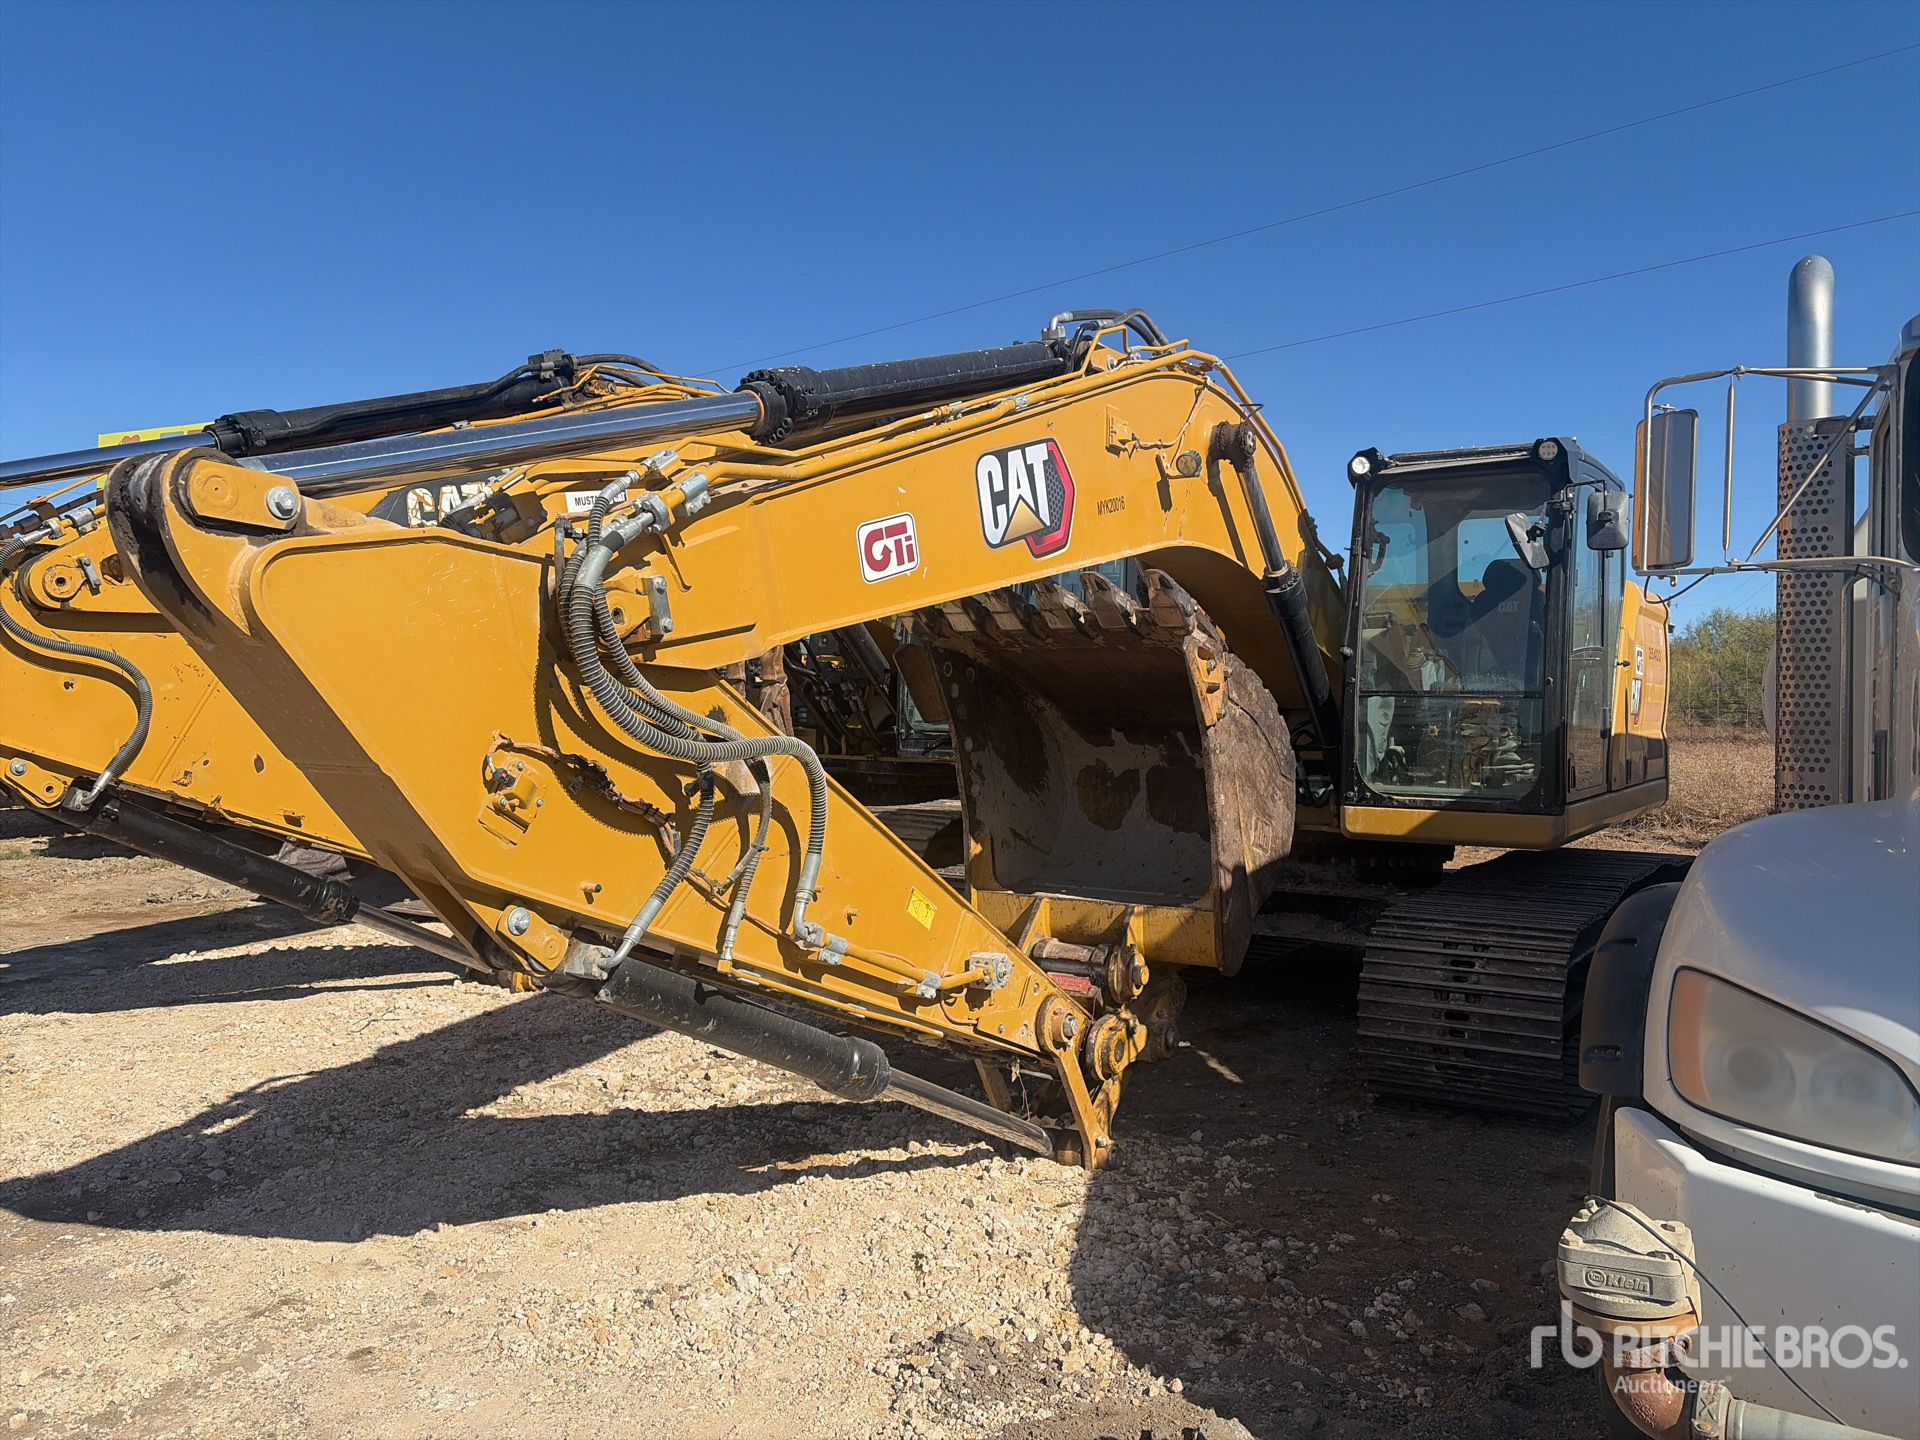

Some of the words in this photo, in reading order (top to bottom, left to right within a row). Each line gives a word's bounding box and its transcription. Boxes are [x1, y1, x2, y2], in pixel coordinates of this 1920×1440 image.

[977, 443, 1051, 544] CAT
[1096, 495, 1126, 516] MYK20016
[1605, 1273, 1650, 1293] Klein
